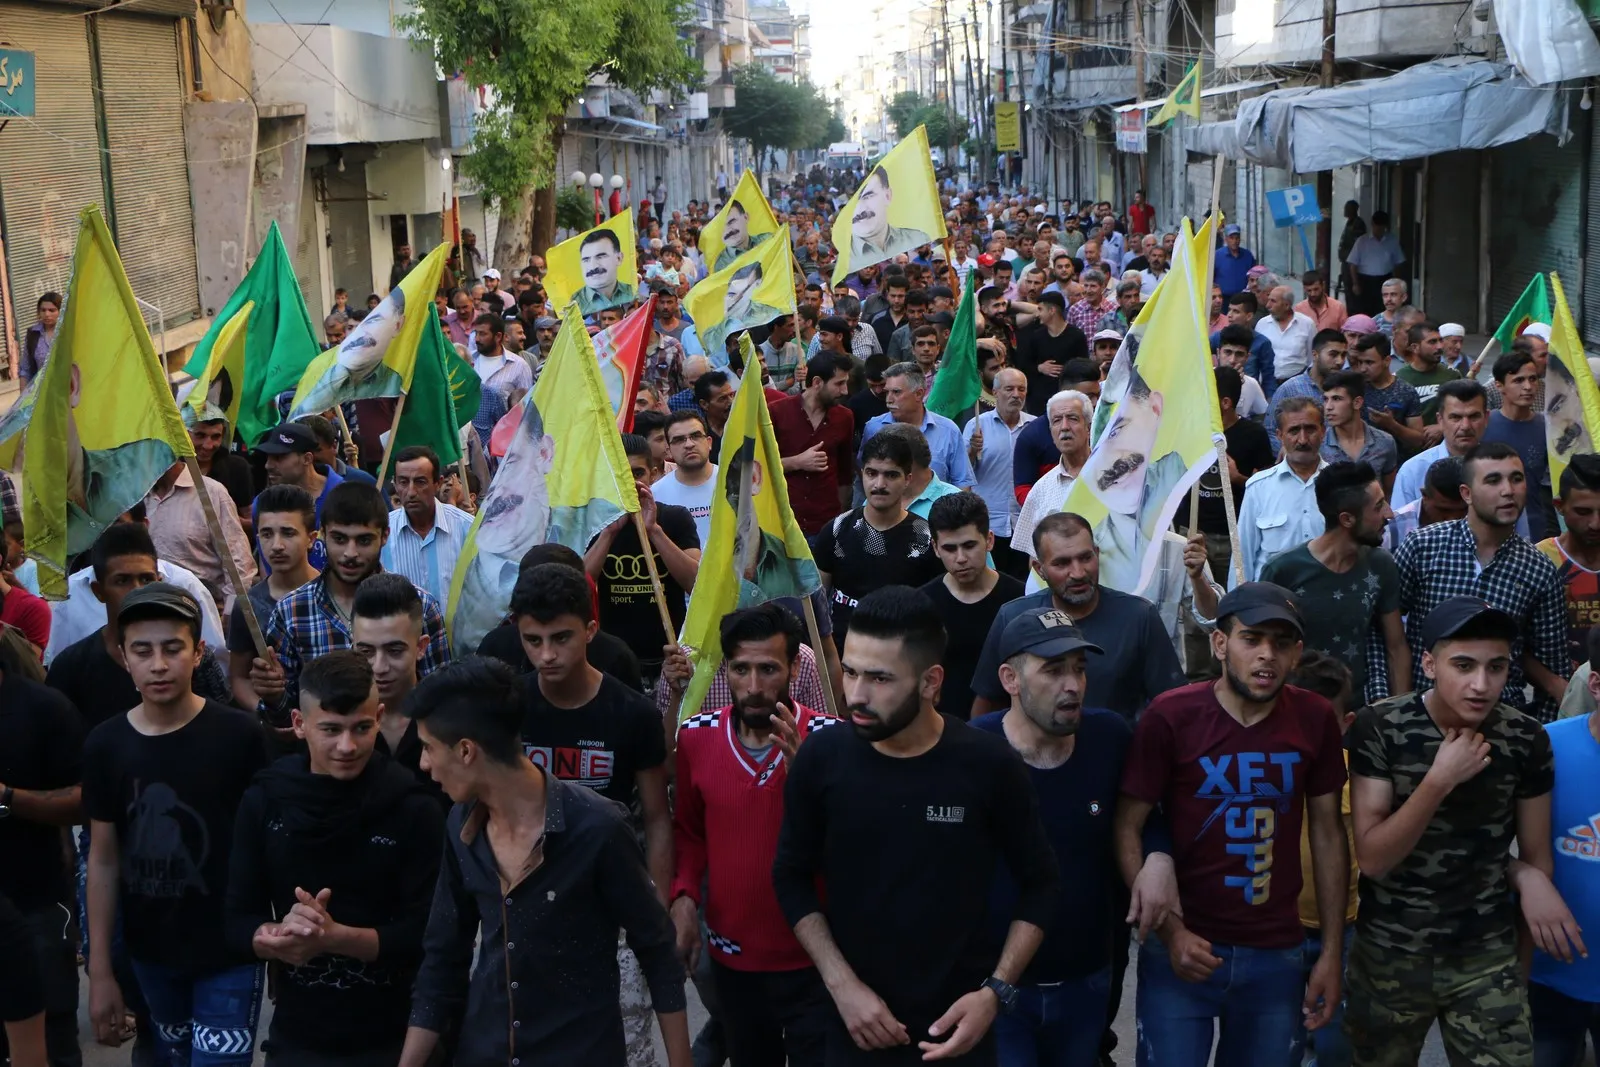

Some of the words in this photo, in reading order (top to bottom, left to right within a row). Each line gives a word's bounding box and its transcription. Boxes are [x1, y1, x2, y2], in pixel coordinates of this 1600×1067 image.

[0, 56, 24, 96] مرك
[1283, 188, 1305, 216] P
[1415, 384, 1440, 396] NIKE
[1198, 490, 1224, 498] RIGINA
[689, 505, 711, 518] REDI
[611, 596, 635, 605] sport.
[1197, 752, 1302, 796] XFT
[926, 805, 951, 817] 5.11
[1556, 836, 1600, 861] ad
